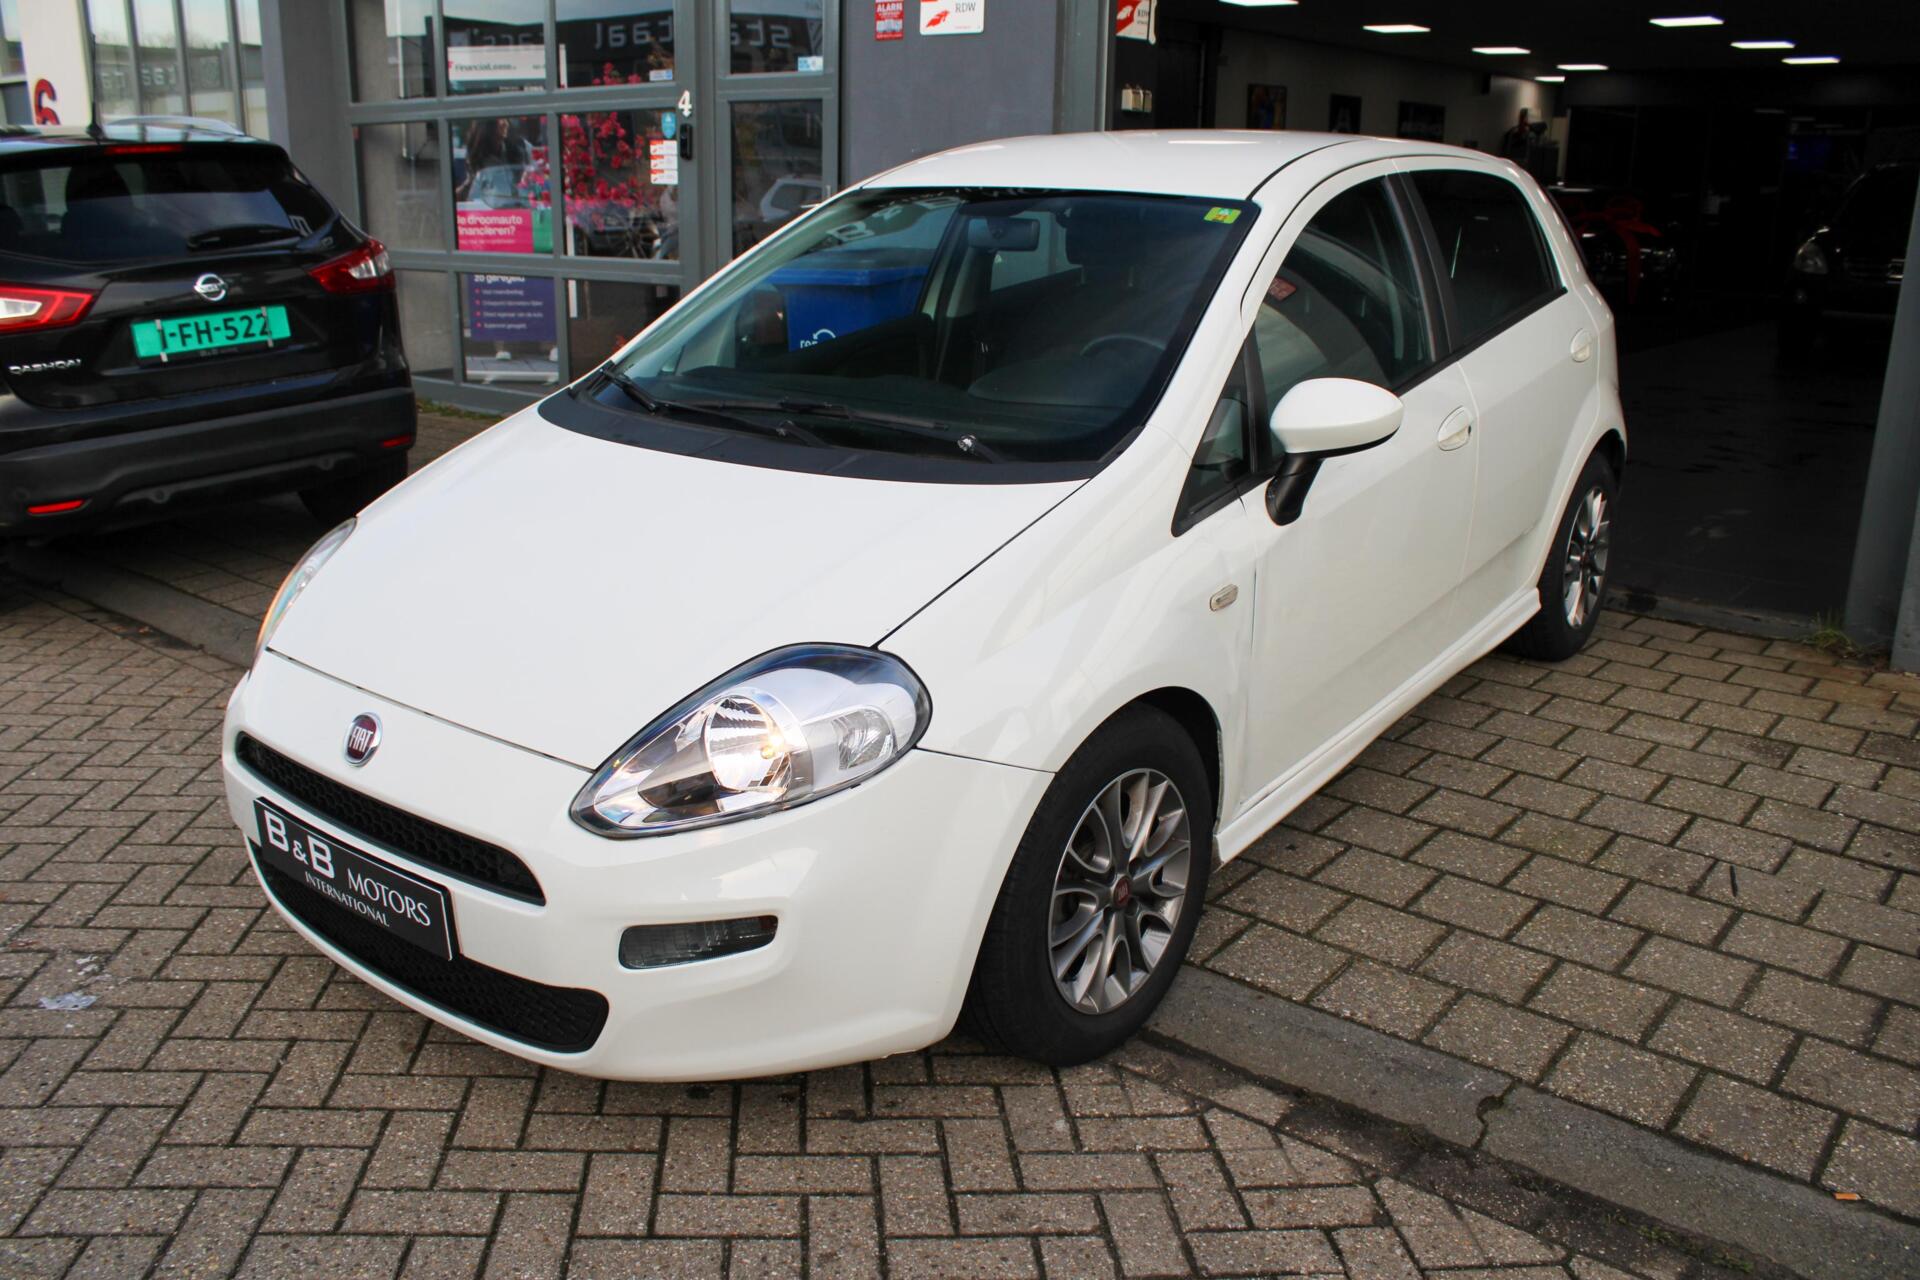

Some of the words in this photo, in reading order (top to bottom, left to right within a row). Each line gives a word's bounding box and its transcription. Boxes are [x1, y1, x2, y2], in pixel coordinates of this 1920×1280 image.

[877, 2, 903, 13] ALARM
[955, 2, 977, 13] RDW
[678, 90, 692, 117] 4
[467, 214, 523, 225] droomauto
[349, 725, 374, 753] FIAT
[305, 871, 390, 928] INTERNATIONAL
[347, 868, 431, 927] MOTORS
